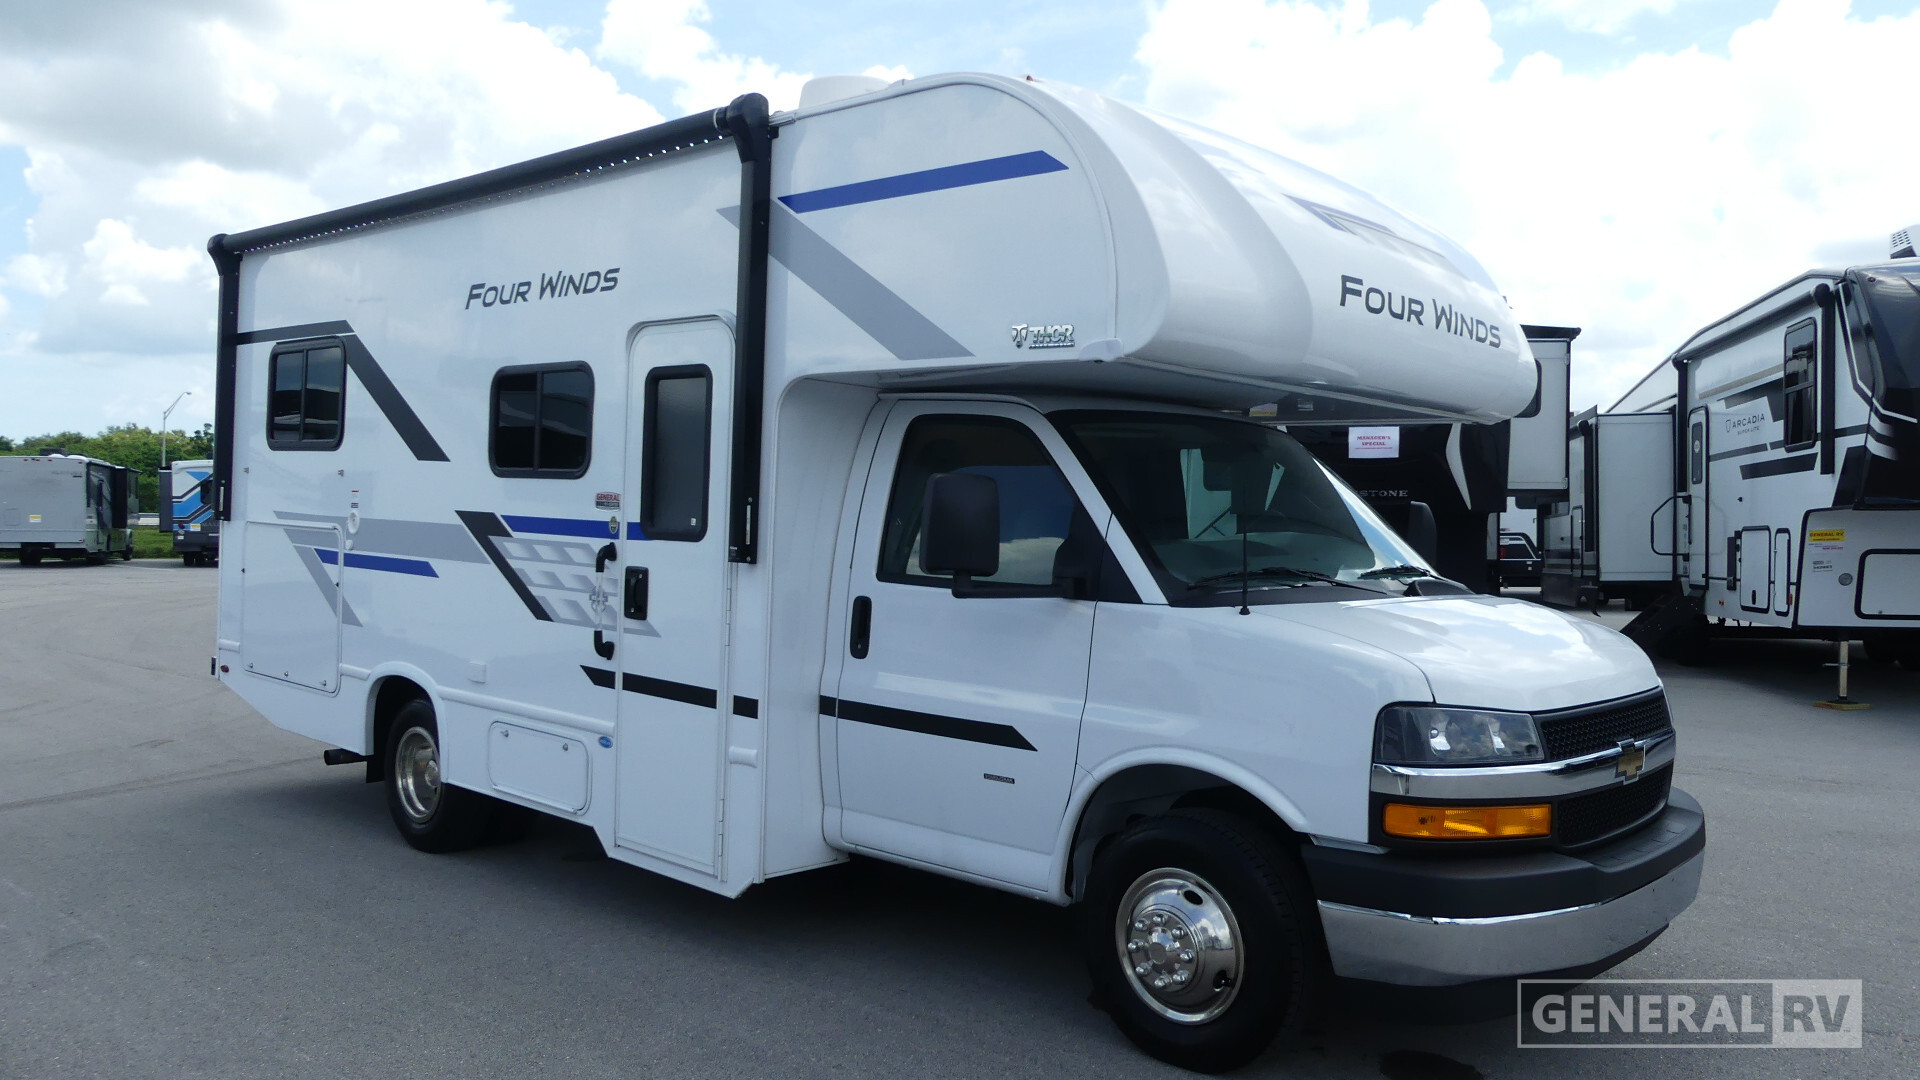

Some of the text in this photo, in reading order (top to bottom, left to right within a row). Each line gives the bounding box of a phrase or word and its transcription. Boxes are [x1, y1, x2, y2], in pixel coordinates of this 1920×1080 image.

[465, 268, 621, 310] FOUR WINDS
[1339, 274, 1502, 349] FOUR WINDS
[1029, 325, 1074, 344] THOR
[1732, 413, 1765, 429] ARCADIA
[597, 493, 620, 501] GENERAL
